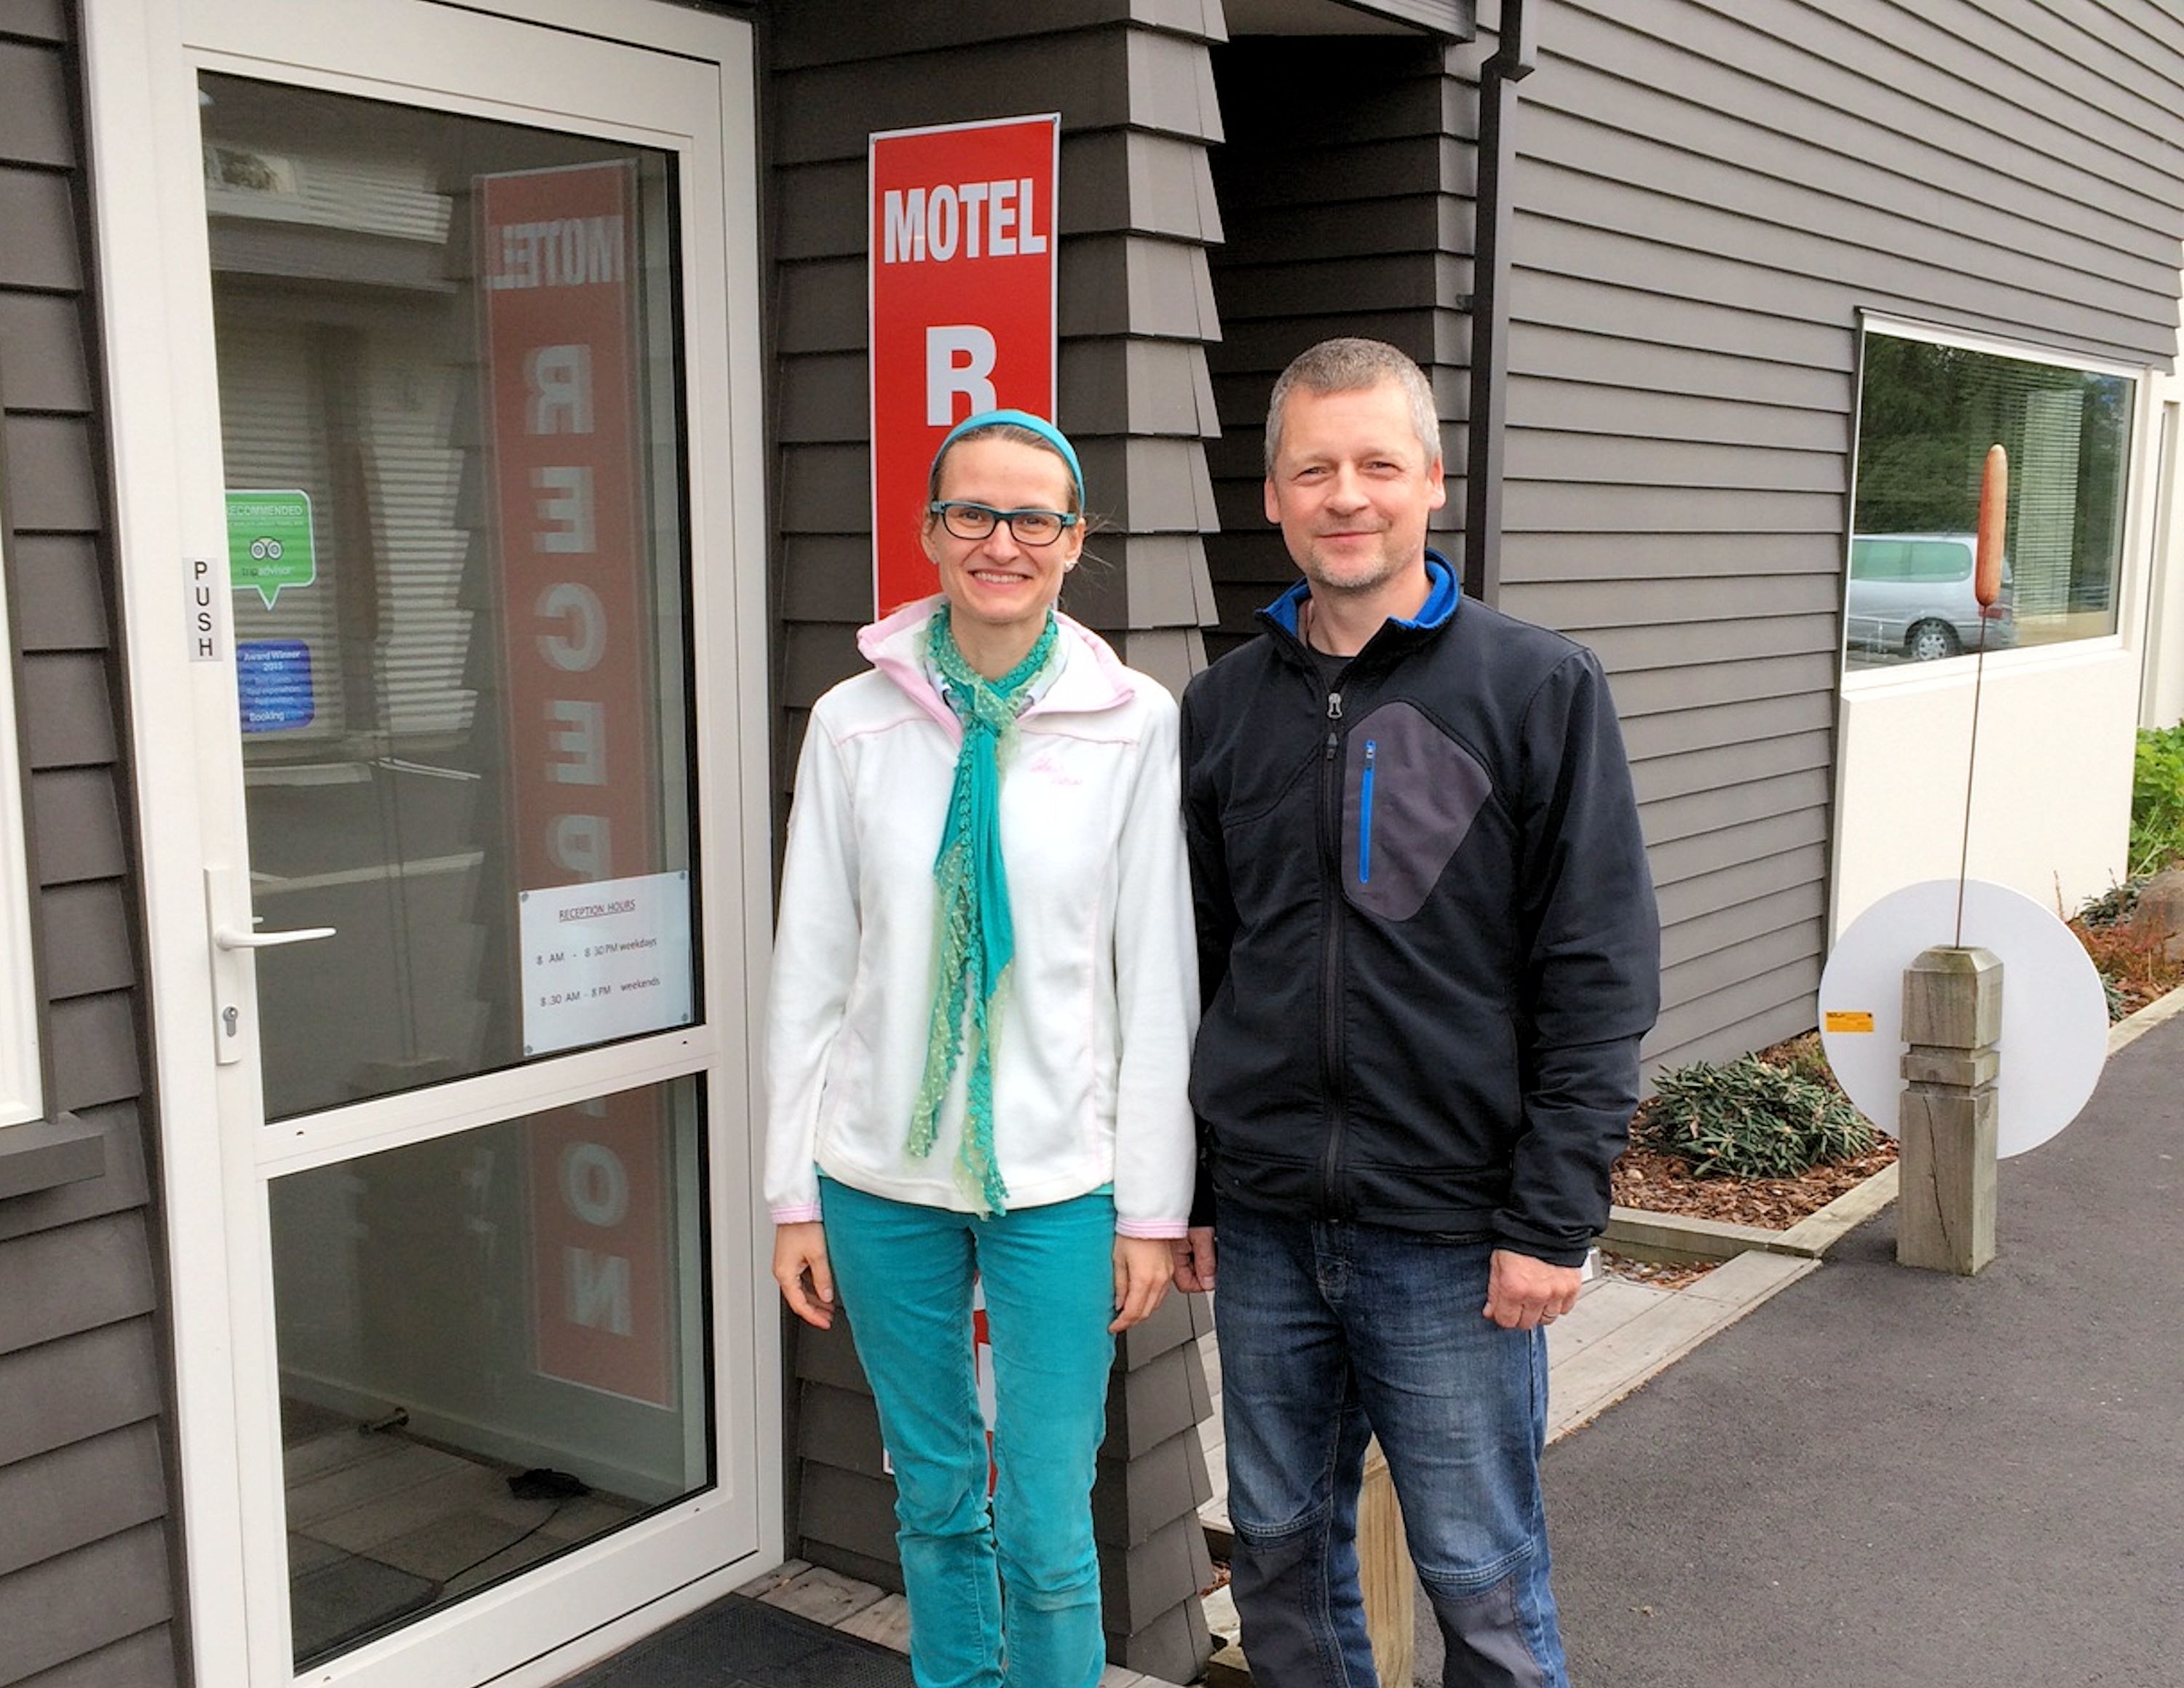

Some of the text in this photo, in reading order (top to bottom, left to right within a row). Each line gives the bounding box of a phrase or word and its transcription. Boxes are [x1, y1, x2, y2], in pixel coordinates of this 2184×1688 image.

[884, 178, 1048, 263] MOTEL
[194, 560, 213, 657] PUSH
[244, 650, 301, 661] Award Winner
[263, 662, 283, 671] 2015
[559, 899, 636, 922] RECEPTION HOURS
[548, 952, 564, 963] AM
[620, 938, 657, 952] weekdays
[565, 991, 580, 1002] AM
[620, 977, 660, 992] weekends
